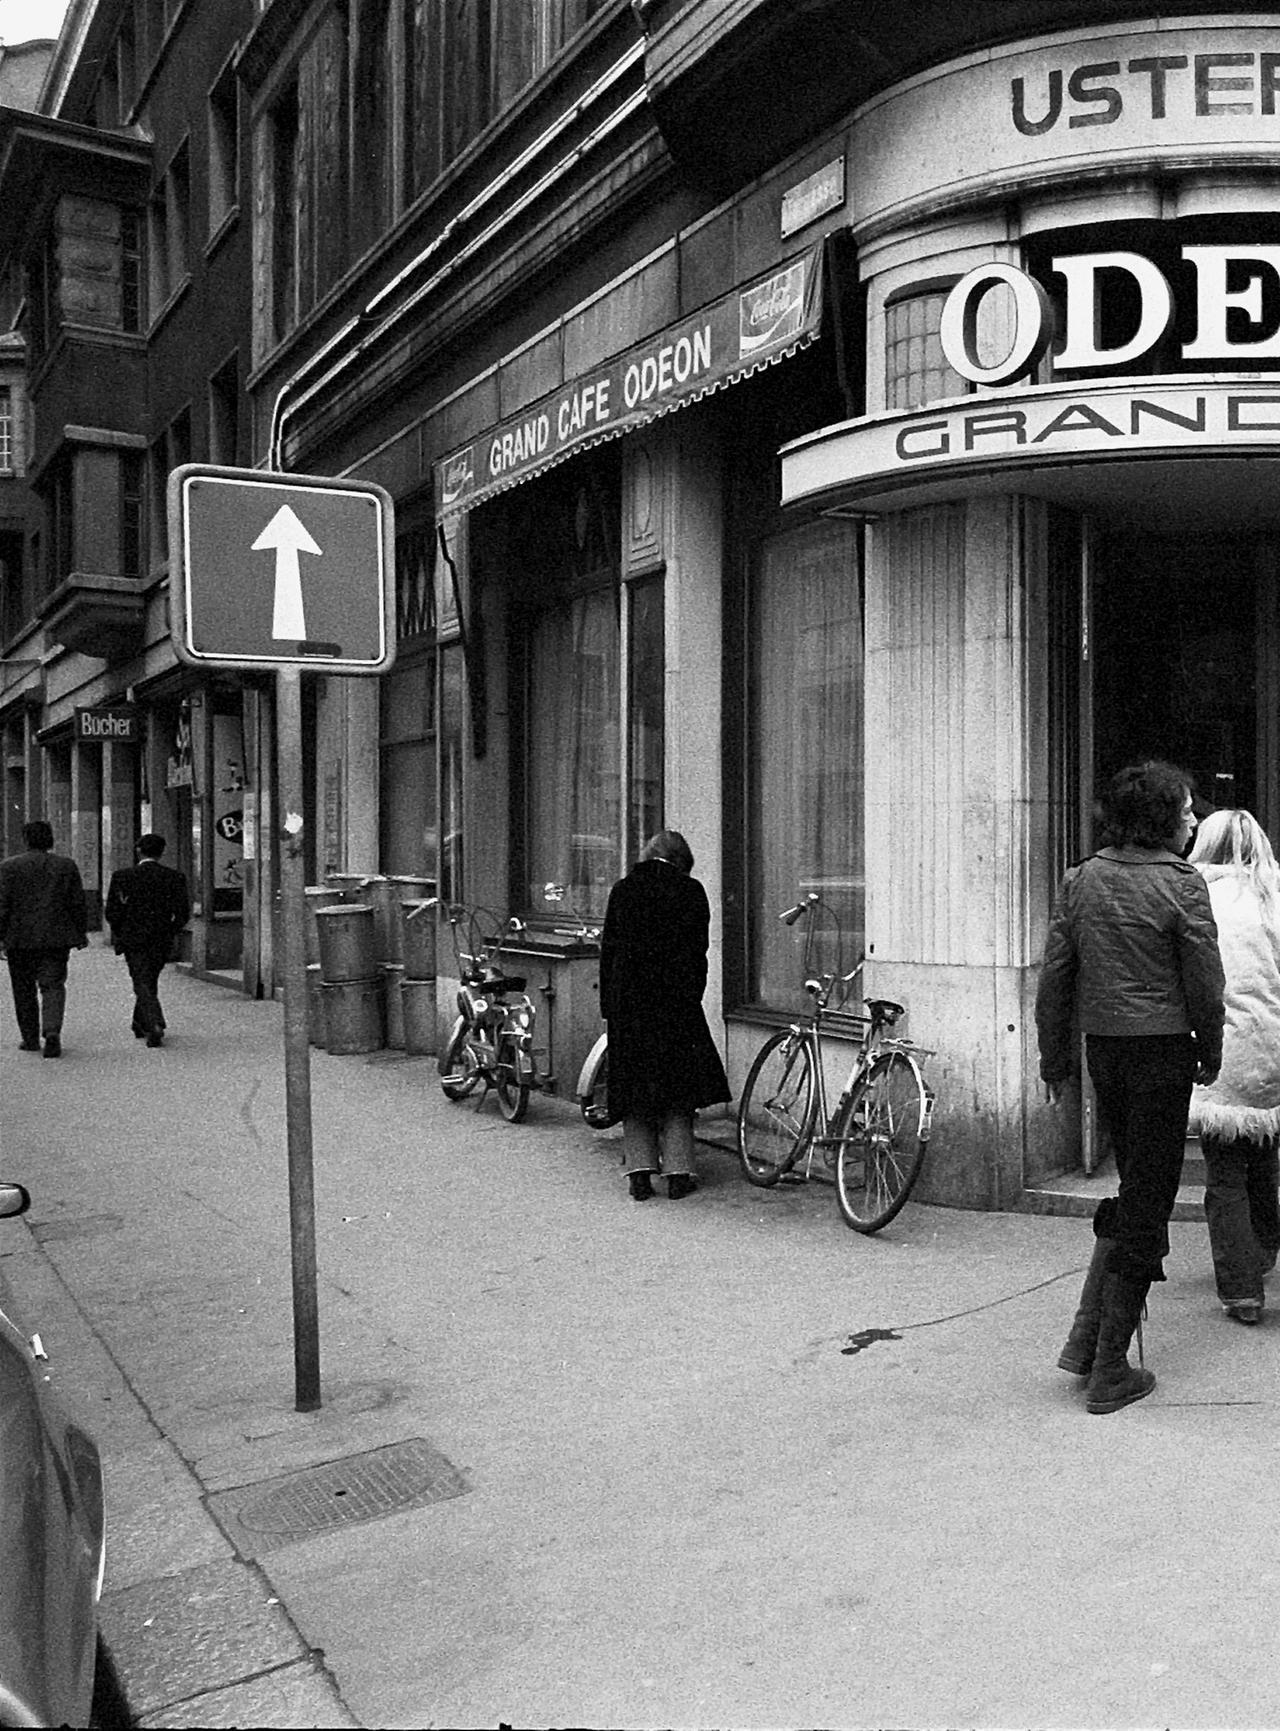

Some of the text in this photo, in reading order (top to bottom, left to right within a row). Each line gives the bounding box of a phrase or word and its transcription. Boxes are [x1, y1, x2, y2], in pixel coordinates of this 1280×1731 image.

[489, 415, 549, 476] GRAND
[558, 380, 611, 441] CAFE
[624, 325, 712, 408] ODEON
